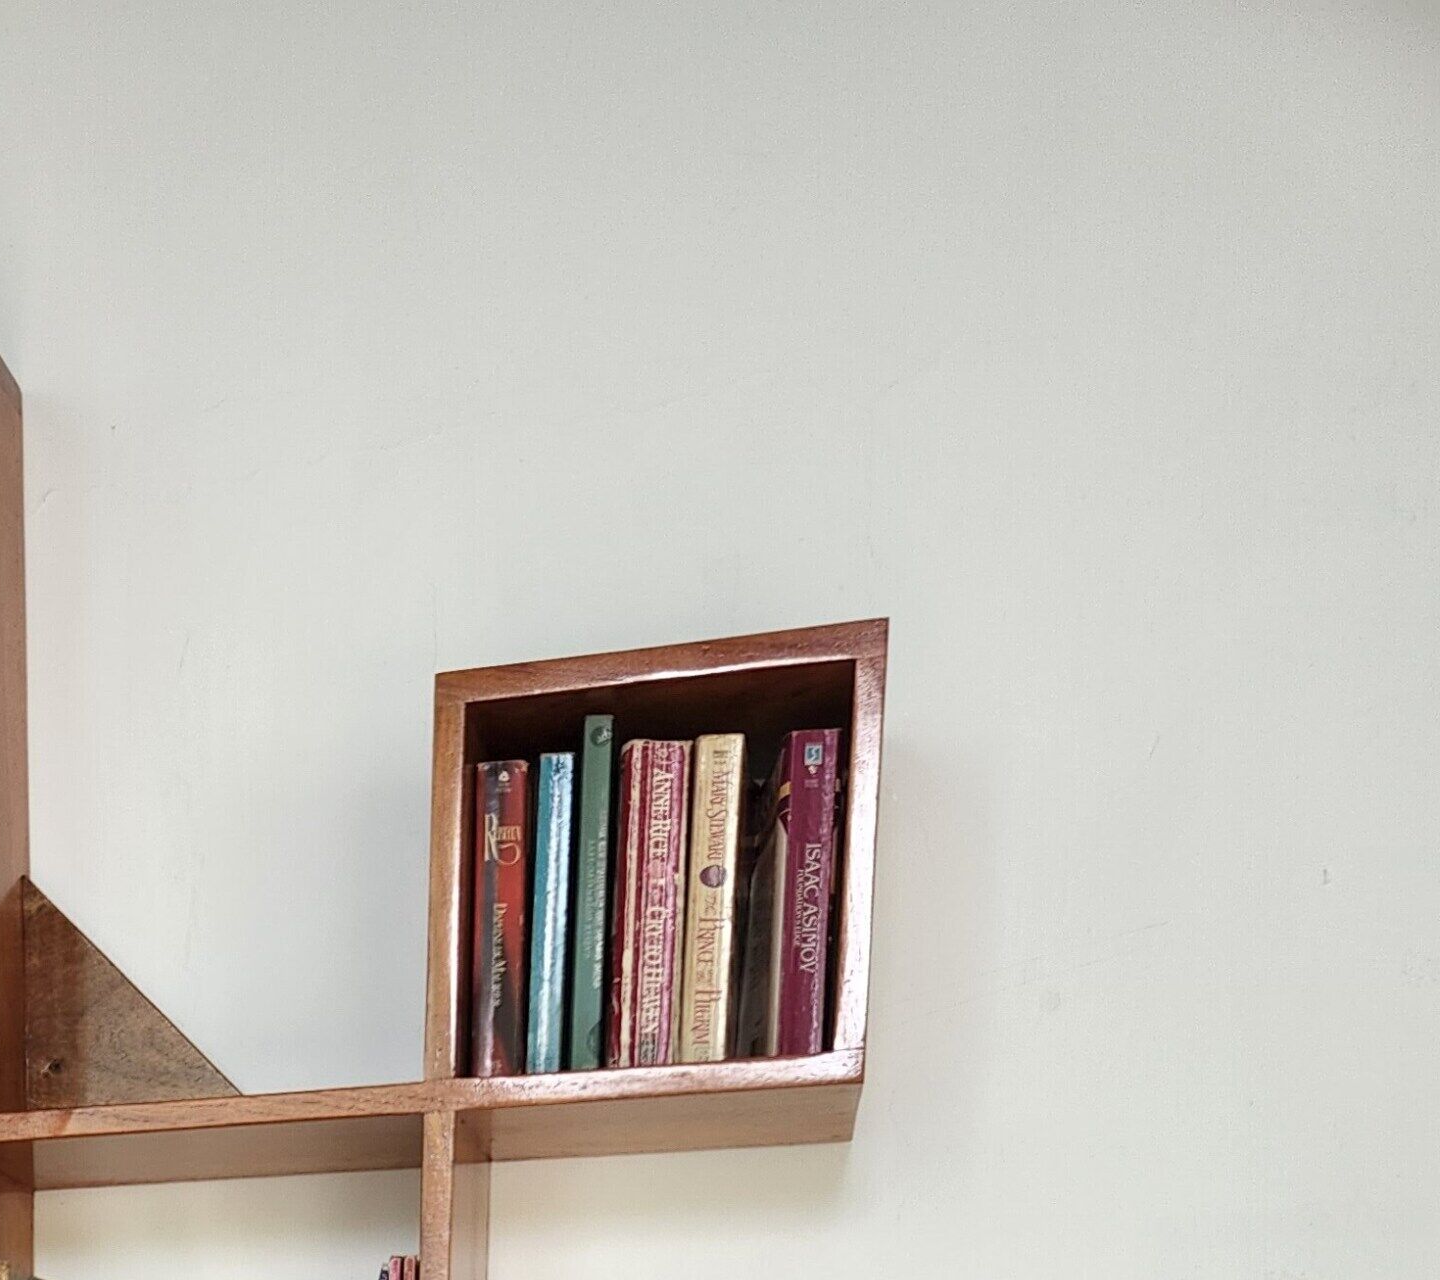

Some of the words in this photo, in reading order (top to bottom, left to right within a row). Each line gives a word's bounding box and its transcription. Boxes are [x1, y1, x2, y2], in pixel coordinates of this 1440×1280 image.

[651, 768, 673, 818] ANNE
[710, 770, 731, 806] MARY
[649, 820, 671, 860] RICE
[706, 808, 729, 861] STEWART
[804, 842, 823, 898] ISAAC
[798, 903, 822, 975] ASIMOV
[640, 970, 662, 1033] HEAVEN
